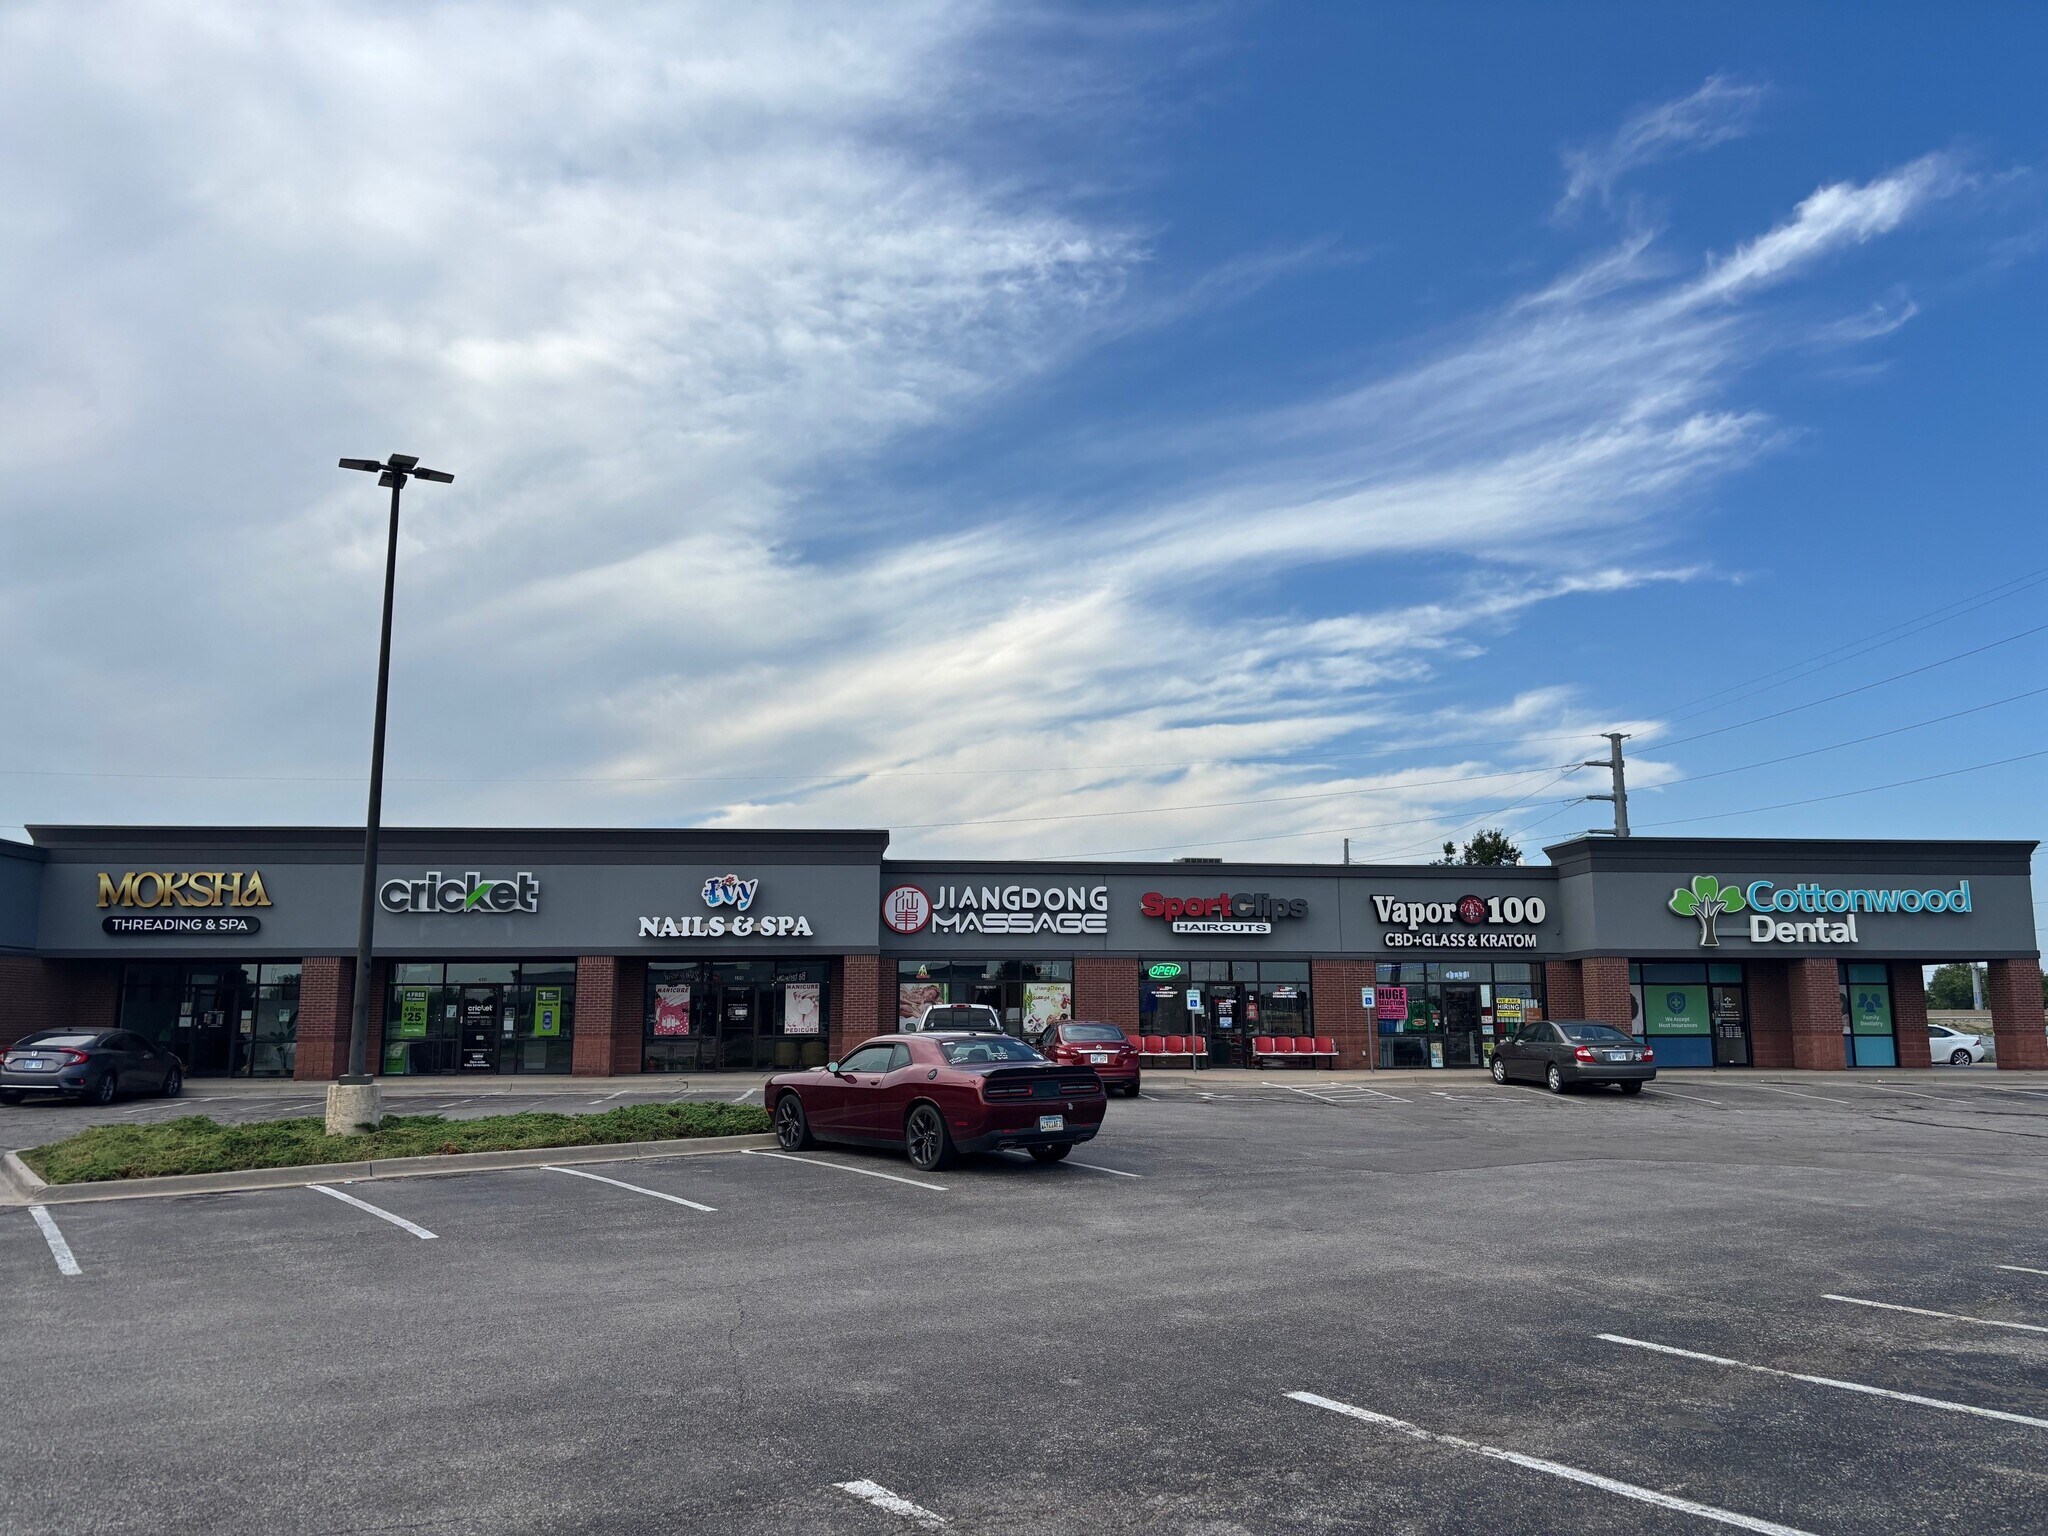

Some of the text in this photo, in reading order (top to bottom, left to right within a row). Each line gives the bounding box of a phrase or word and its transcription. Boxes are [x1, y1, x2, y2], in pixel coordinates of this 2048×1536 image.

[96, 870, 272, 908] MOKSHA
[380, 872, 539, 912] cricket
[703, 875, 758, 911] Ivy
[932, 885, 1108, 911] JIANGDONG
[1746, 880, 1972, 914] Cottonwood
[932, 912, 1108, 934] MASSAGE
[1372, 895, 1546, 931] Vapor 100
[112, 919, 248, 930] THREADING & SPA
[638, 916, 814, 937] NAILS & SPA
[1176, 923, 1267, 932] HAIRCUTS
[1749, 914, 1858, 943] Dental
[1385, 933, 1537, 948] CBD+GLASS & KRATOM
[1151, 966, 1177, 976] OPEN
[1378, 989, 1404, 999] HUGE
[404, 1012, 422, 1021] $25
